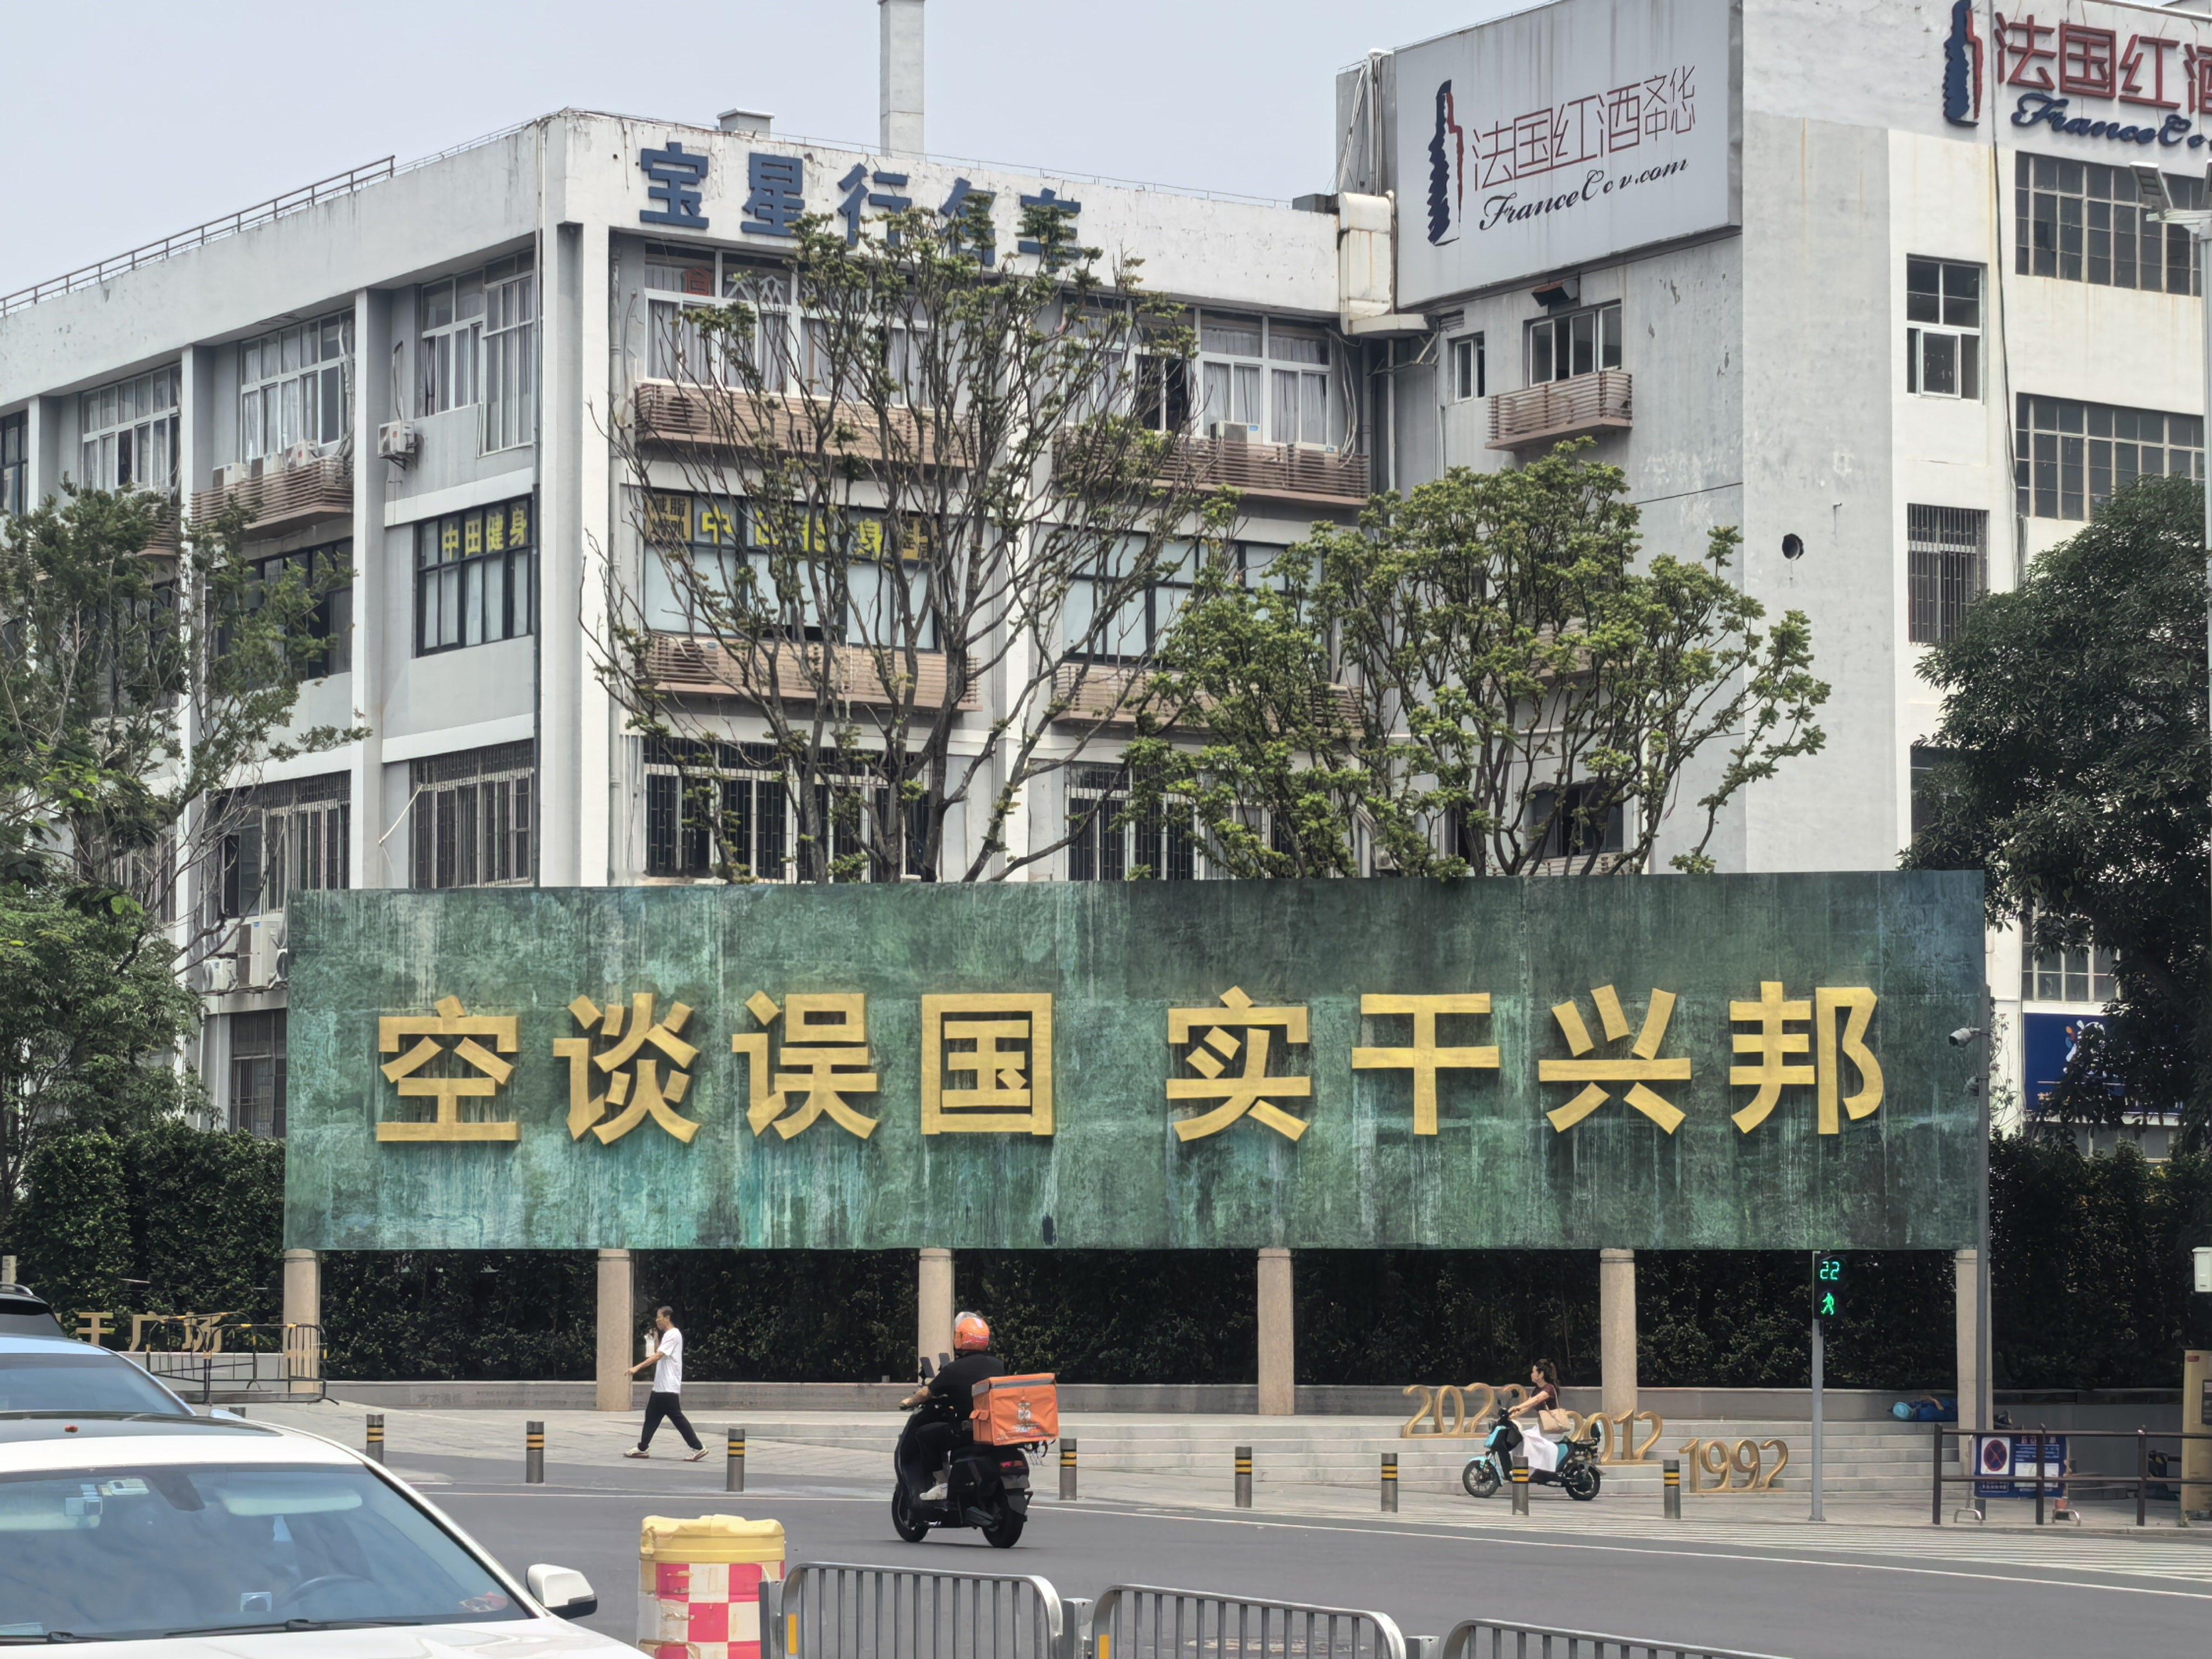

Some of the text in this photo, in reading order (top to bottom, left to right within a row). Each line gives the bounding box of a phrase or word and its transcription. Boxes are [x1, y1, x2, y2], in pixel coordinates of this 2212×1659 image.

[1643, 65, 1695, 110] 文化
[1472, 83, 1641, 191] 法国红酒
[1644, 101, 1695, 141] 中心
[2011, 92, 2212, 149] FranceCo
[376, 981, 1885, 1145] 空谈误国 实干兴邦
[1820, 1261, 1839, 1280] 22
[1678, 1438, 1789, 1493] 1992
